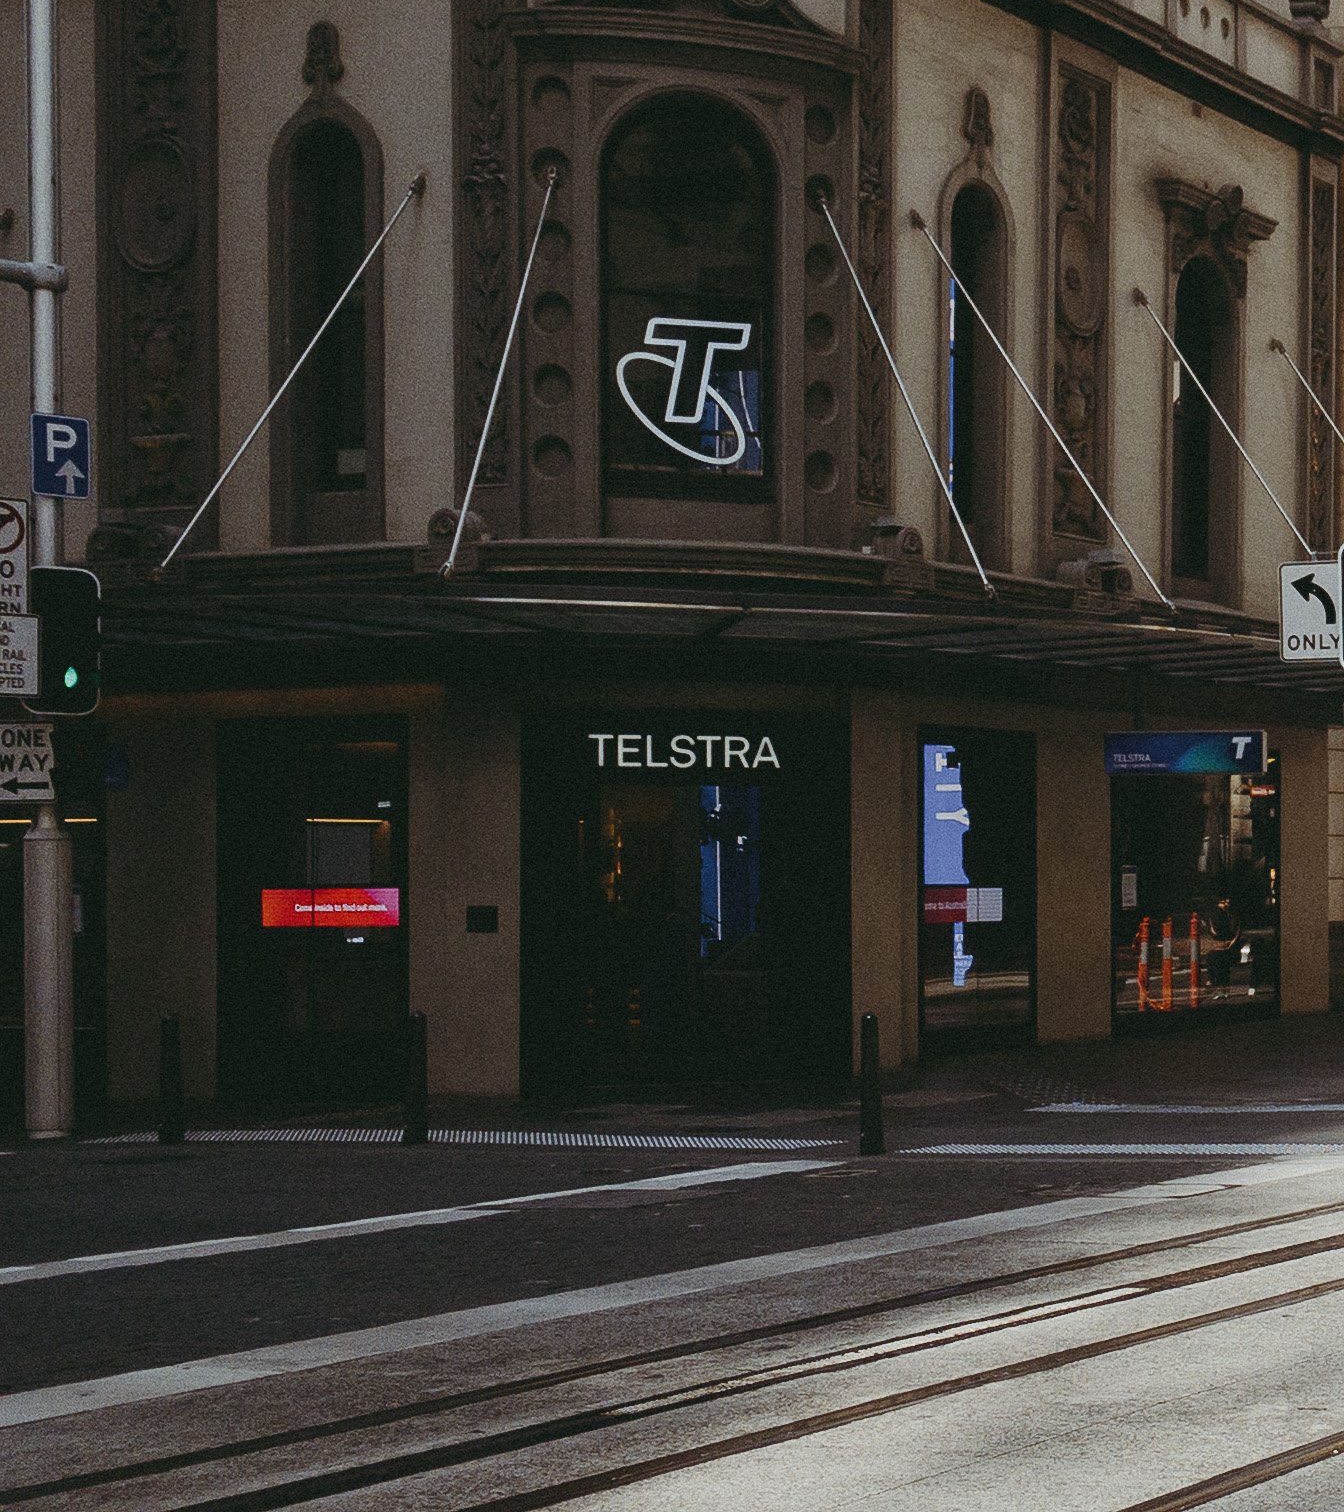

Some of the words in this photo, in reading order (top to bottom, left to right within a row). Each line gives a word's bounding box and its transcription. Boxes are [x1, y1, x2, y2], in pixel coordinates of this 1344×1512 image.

[46, 422, 77, 462] P
[0, 560, 14, 579] O
[1287, 634, 1340, 651] ONLY
[1, 729, 47, 749] ONE
[1232, 736, 1252, 759] T
[588, 734, 781, 769] TELSTRA
[1113, 753, 1151, 763] TELSTRA
